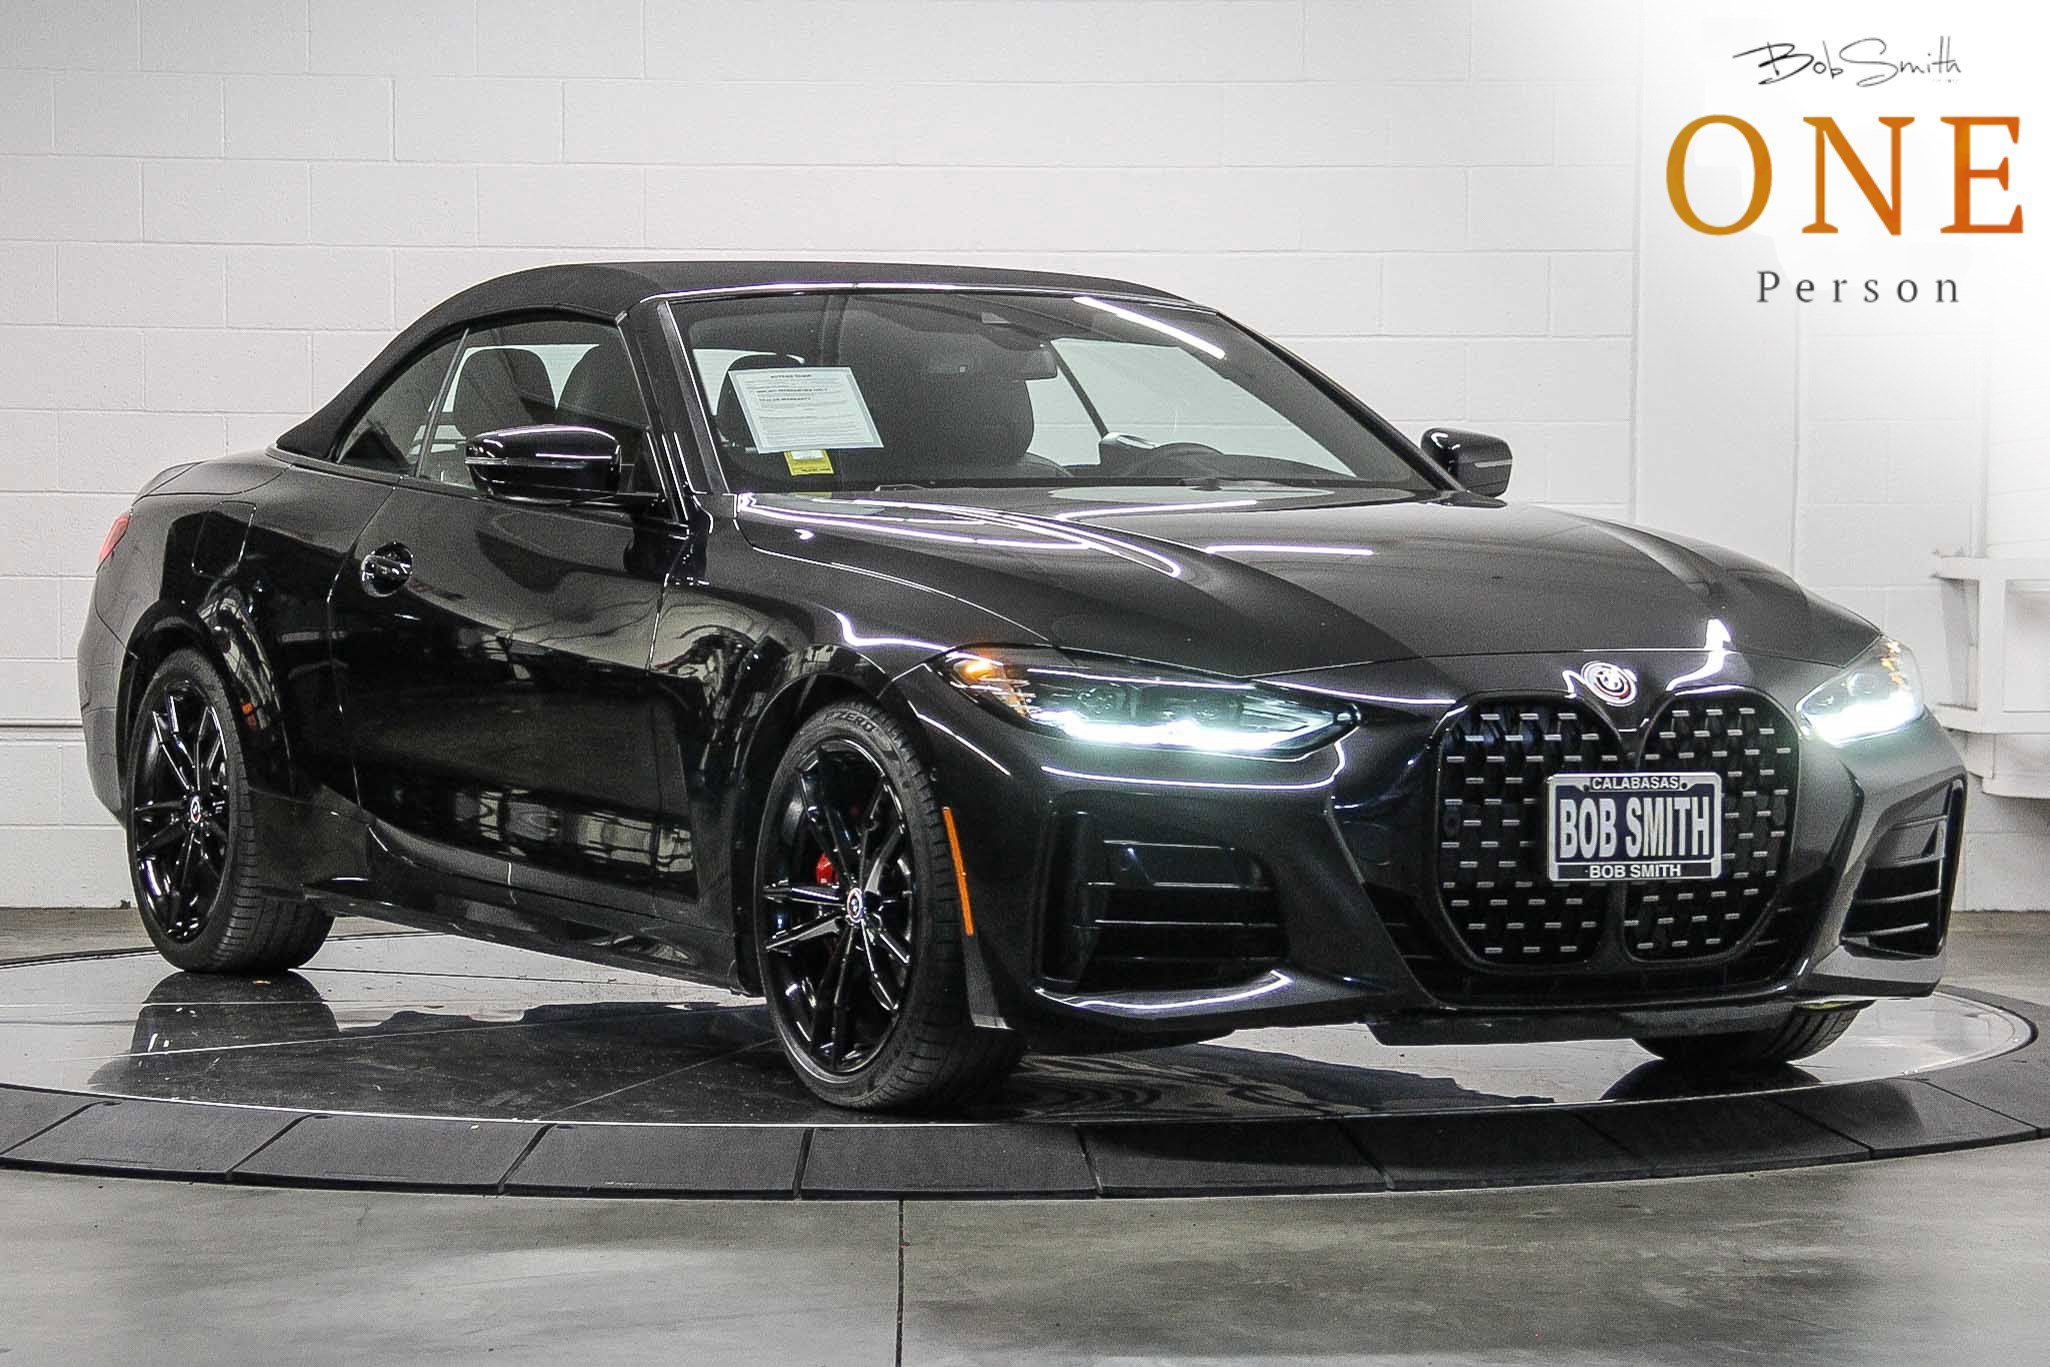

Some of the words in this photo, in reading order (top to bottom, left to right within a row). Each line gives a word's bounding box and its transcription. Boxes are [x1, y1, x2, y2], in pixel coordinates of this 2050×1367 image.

[1592, 776, 1680, 790] CALABASAS
[1560, 798, 1617, 859] BOB
[1625, 797, 1709, 858] SMITH
[1589, 865, 1626, 879] BOB
[1630, 864, 1682, 878] SMITH
